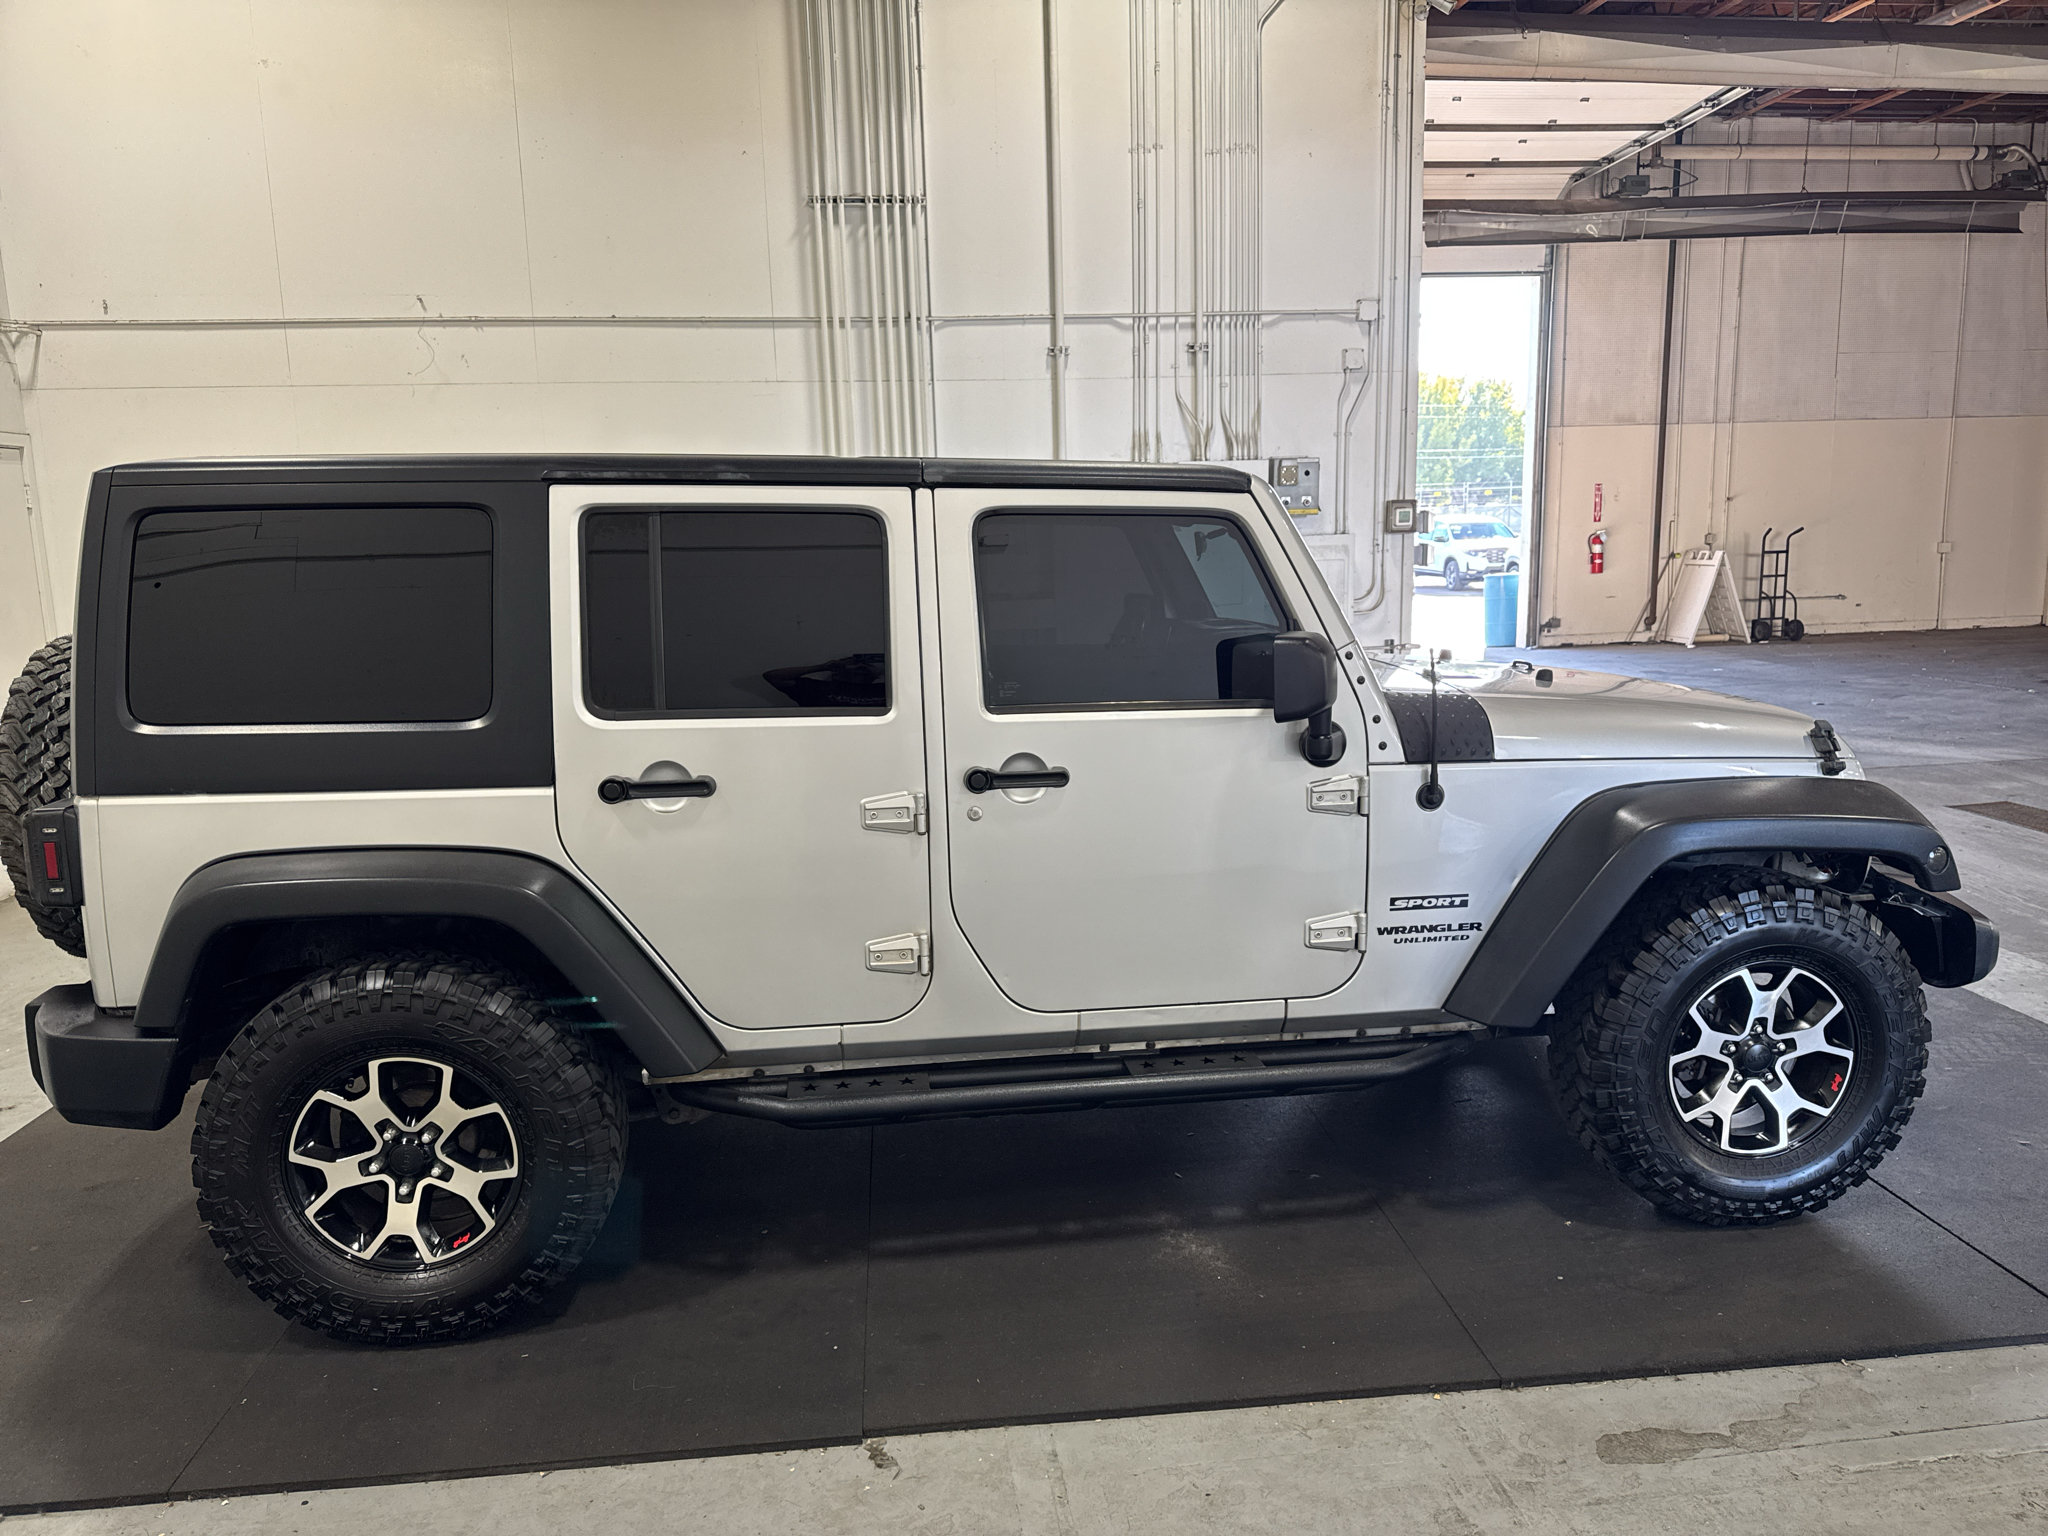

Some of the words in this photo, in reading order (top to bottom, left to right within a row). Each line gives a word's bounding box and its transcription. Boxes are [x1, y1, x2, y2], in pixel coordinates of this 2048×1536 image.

[1390, 896, 1468, 910] SPORT
[1377, 922, 1483, 936] WRANGLER
[1394, 935, 1470, 944] UNLIMITED
